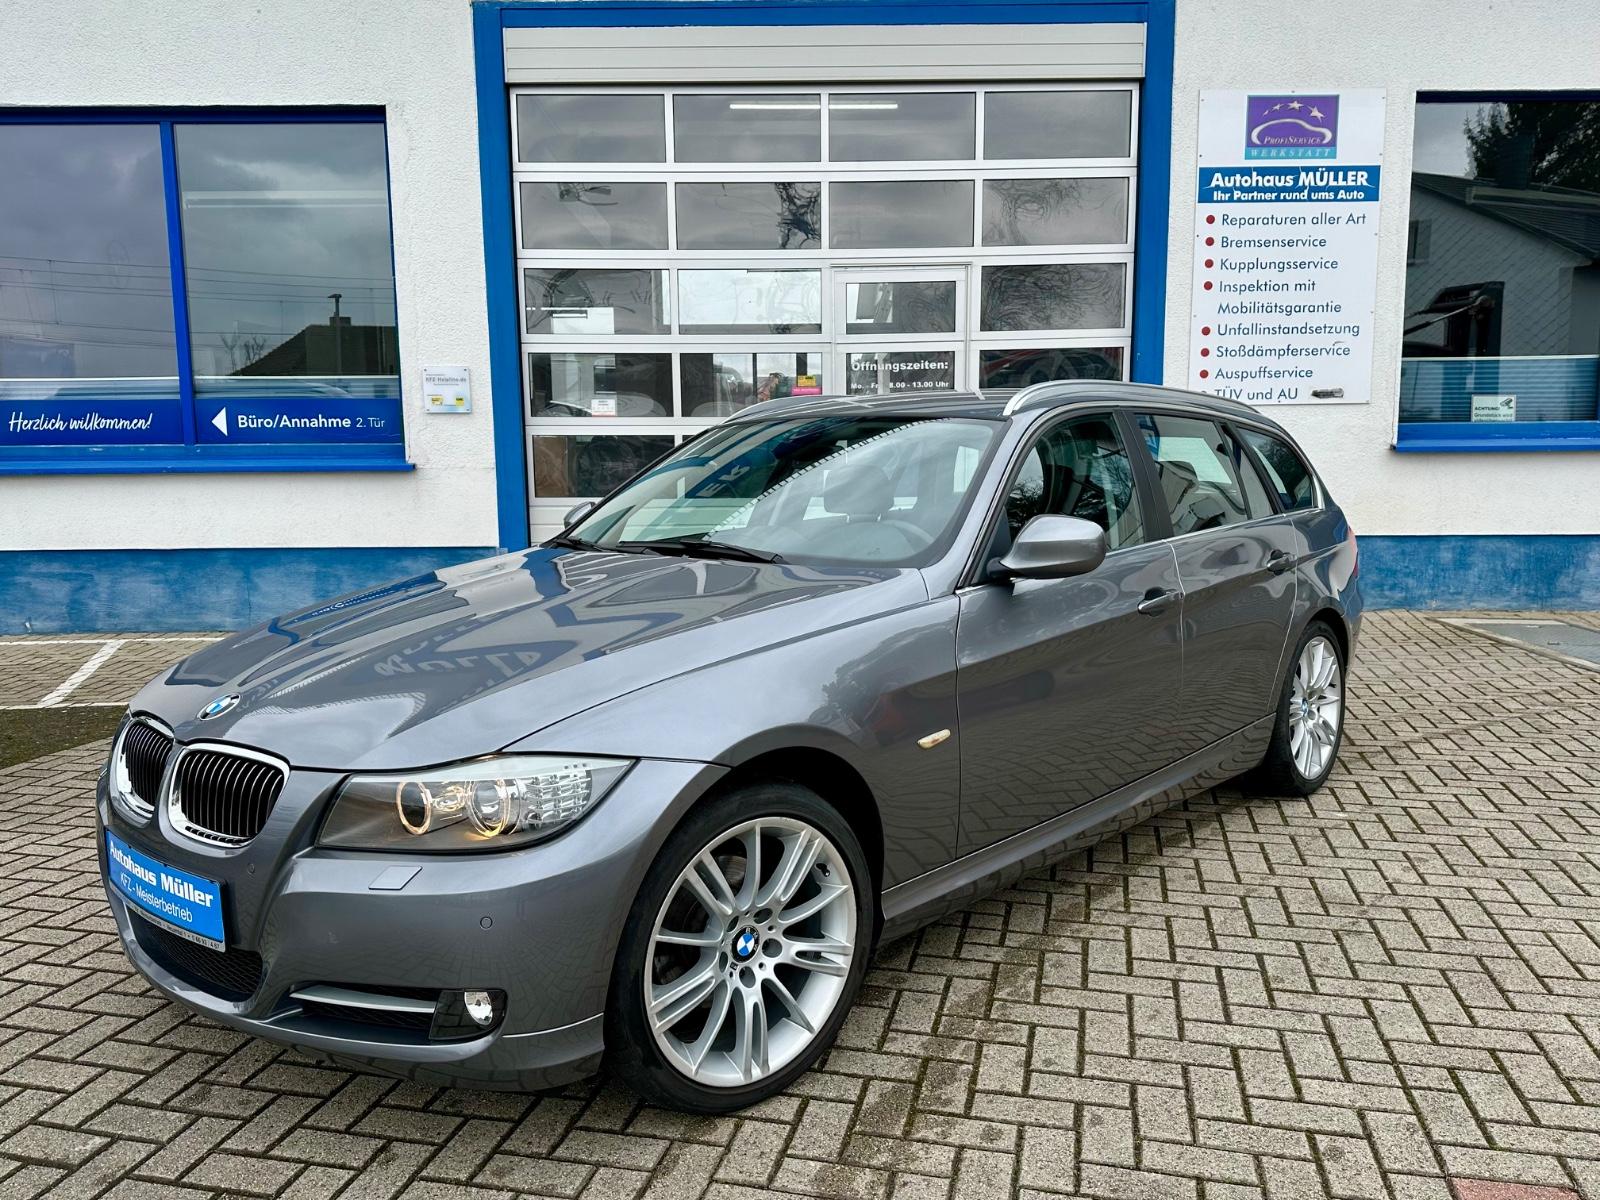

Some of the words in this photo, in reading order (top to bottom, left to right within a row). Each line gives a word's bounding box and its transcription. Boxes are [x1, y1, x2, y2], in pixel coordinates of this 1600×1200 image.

[1250, 148, 1331, 158] WERKSTATT
[1210, 172, 1294, 188] Autohaus
[1298, 168, 1369, 186] MÜLLER
[1213, 190, 1231, 201] Ihr
[1233, 190, 1277, 200] Partner
[1280, 189, 1308, 200] rund
[1311, 191, 1335, 200] ums
[1337, 189, 1365, 200] Auto
[1221, 213, 1306, 229] Reparaturen
[1311, 212, 1342, 225] aller
[1345, 212, 1367, 225] Art
[1221, 235, 1327, 248] Bremsenservice
[1220, 257, 1339, 273] Kupplungsservice
[1219, 280, 1289, 295] Inspektion
[1294, 279, 1316, 292] mit
[1217, 301, 1342, 316] Mobilitätsgarantie
[1217, 322, 1360, 337] Unfallinstandsetzung
[1216, 344, 1351, 360] Stoßdämpferservice
[851, 358, 949, 371] Öffnungszeiten:
[1215, 366, 1313, 381] Auspuffservice
[1247, 388, 1273, 400] und
[1277, 387, 1298, 400] AU
[8, 411, 68, 432] Herzlich
[69, 411, 153, 431] willkommen!
[237, 413, 351, 429] Büro/Annahme
[356, 417, 366, 428] 2.
[367, 417, 385, 428] Tür
[109, 840, 157, 886] Autohaus
[160, 872, 214, 908] Müller
